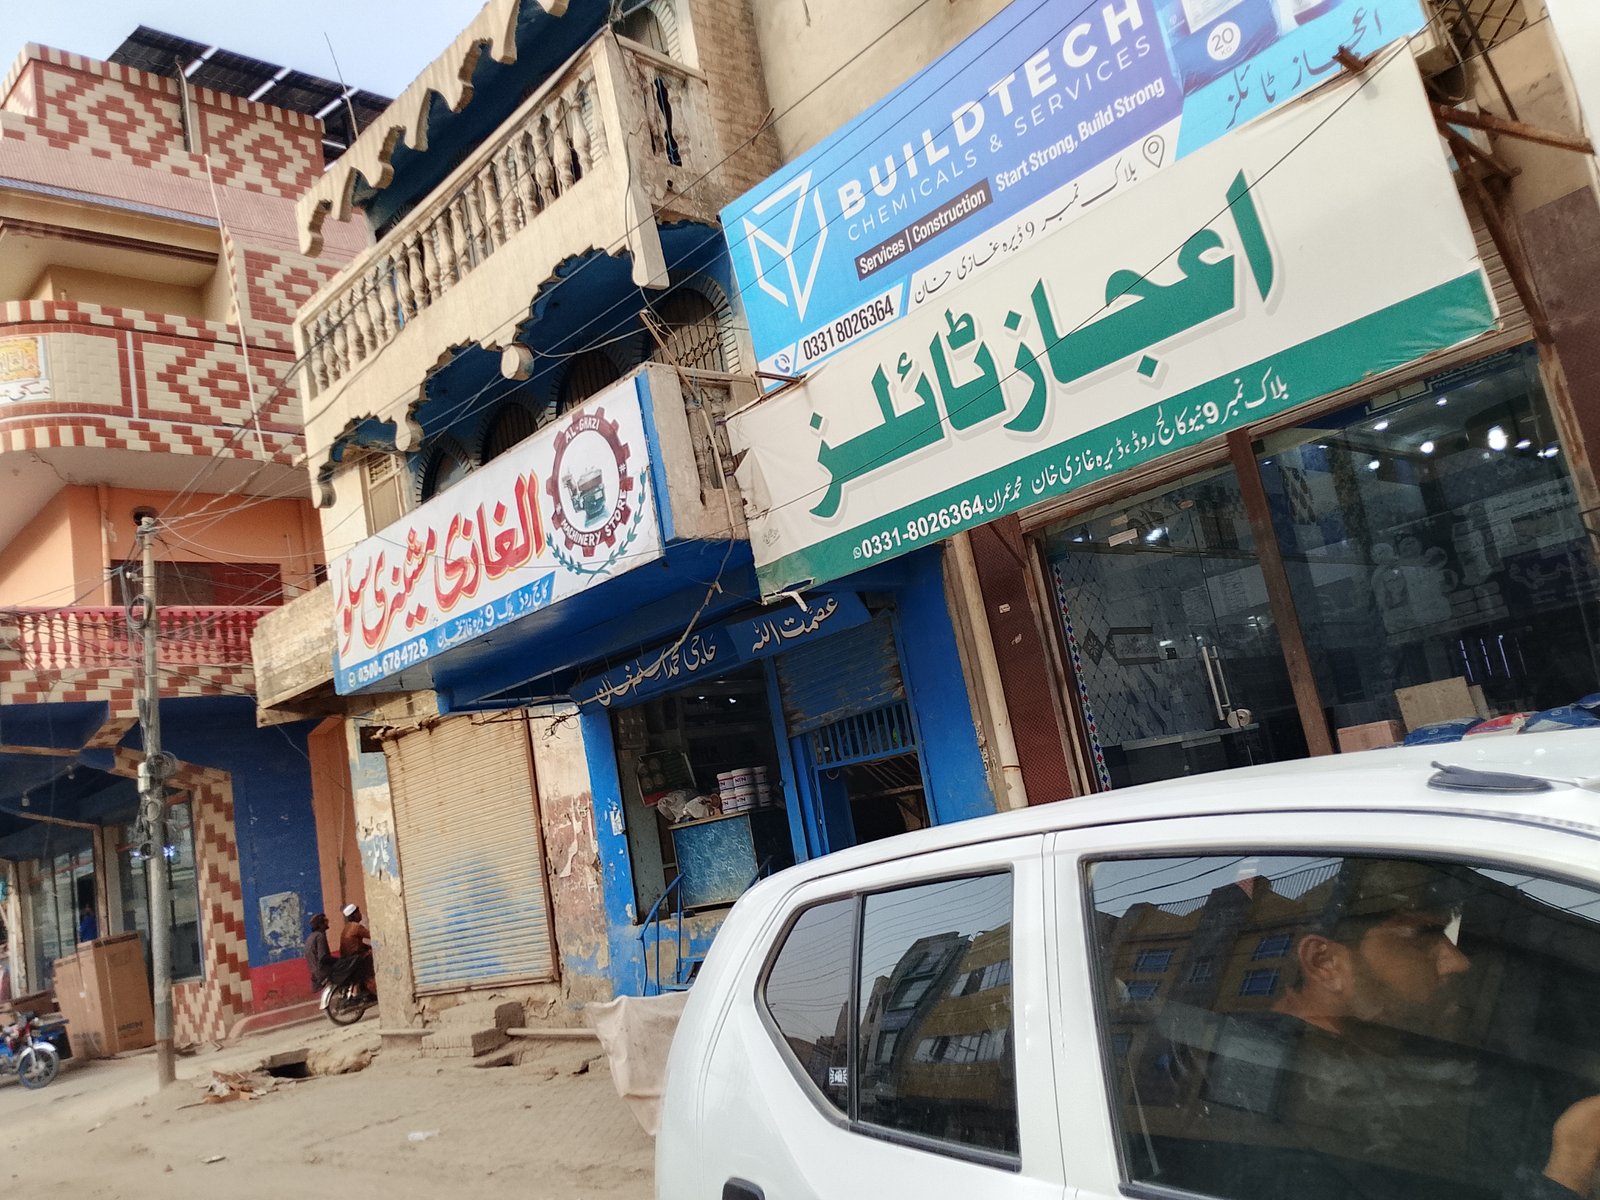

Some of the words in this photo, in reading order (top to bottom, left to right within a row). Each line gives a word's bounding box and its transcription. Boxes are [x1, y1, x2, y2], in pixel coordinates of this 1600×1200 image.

[1211, 26, 1235, 52] 20
[837, 0, 1144, 221] BUILDTECH
[848, 151, 977, 242] CHEMICALS
[989, 134, 1003, 153] &
[1014, 34, 1151, 136] SERVICES
[995, 161, 1029, 193] Start
[1028, 134, 1080, 178] Strong,
[1077, 106, 1112, 143] Build
[1113, 77, 1166, 118] Strong
[1081, 157, 1139, 208] بلاک
[1041, 183, 1080, 232] نمبر
[859, 236, 906, 275] Services
[912, 188, 987, 243] Construction
[1002, 226, 1023, 253] ڈیرہ
[957, 241, 1000, 281] غازی
[914, 268, 952, 304] خان
[1001, 168, 1277, 434] اعجاز
[803, 327, 835, 361] 0331
[835, 294, 895, 343] 8026364
[1221, 378, 1244, 424] نمبر
[1244, 366, 1289, 409] بلاک
[808, 307, 1008, 519] ٹائلز
[1202, 401, 1220, 426] 9
[1009, 475, 1022, 502] محمد
[1031, 464, 1058, 495] خان
[1059, 450, 1095, 484] غازی
[560, 519, 602, 547] MACHINERY
[605, 490, 628, 537] STORE
[985, 482, 1010, 514] عمران
[433, 468, 547, 613] الغازی
[861, 495, 985, 559] 0331-8026364
[485, 604, 496, 627] 9
[667, 642, 681, 680] محمد
[683, 633, 717, 671] حاجی
[595, 665, 634, 707] خان
